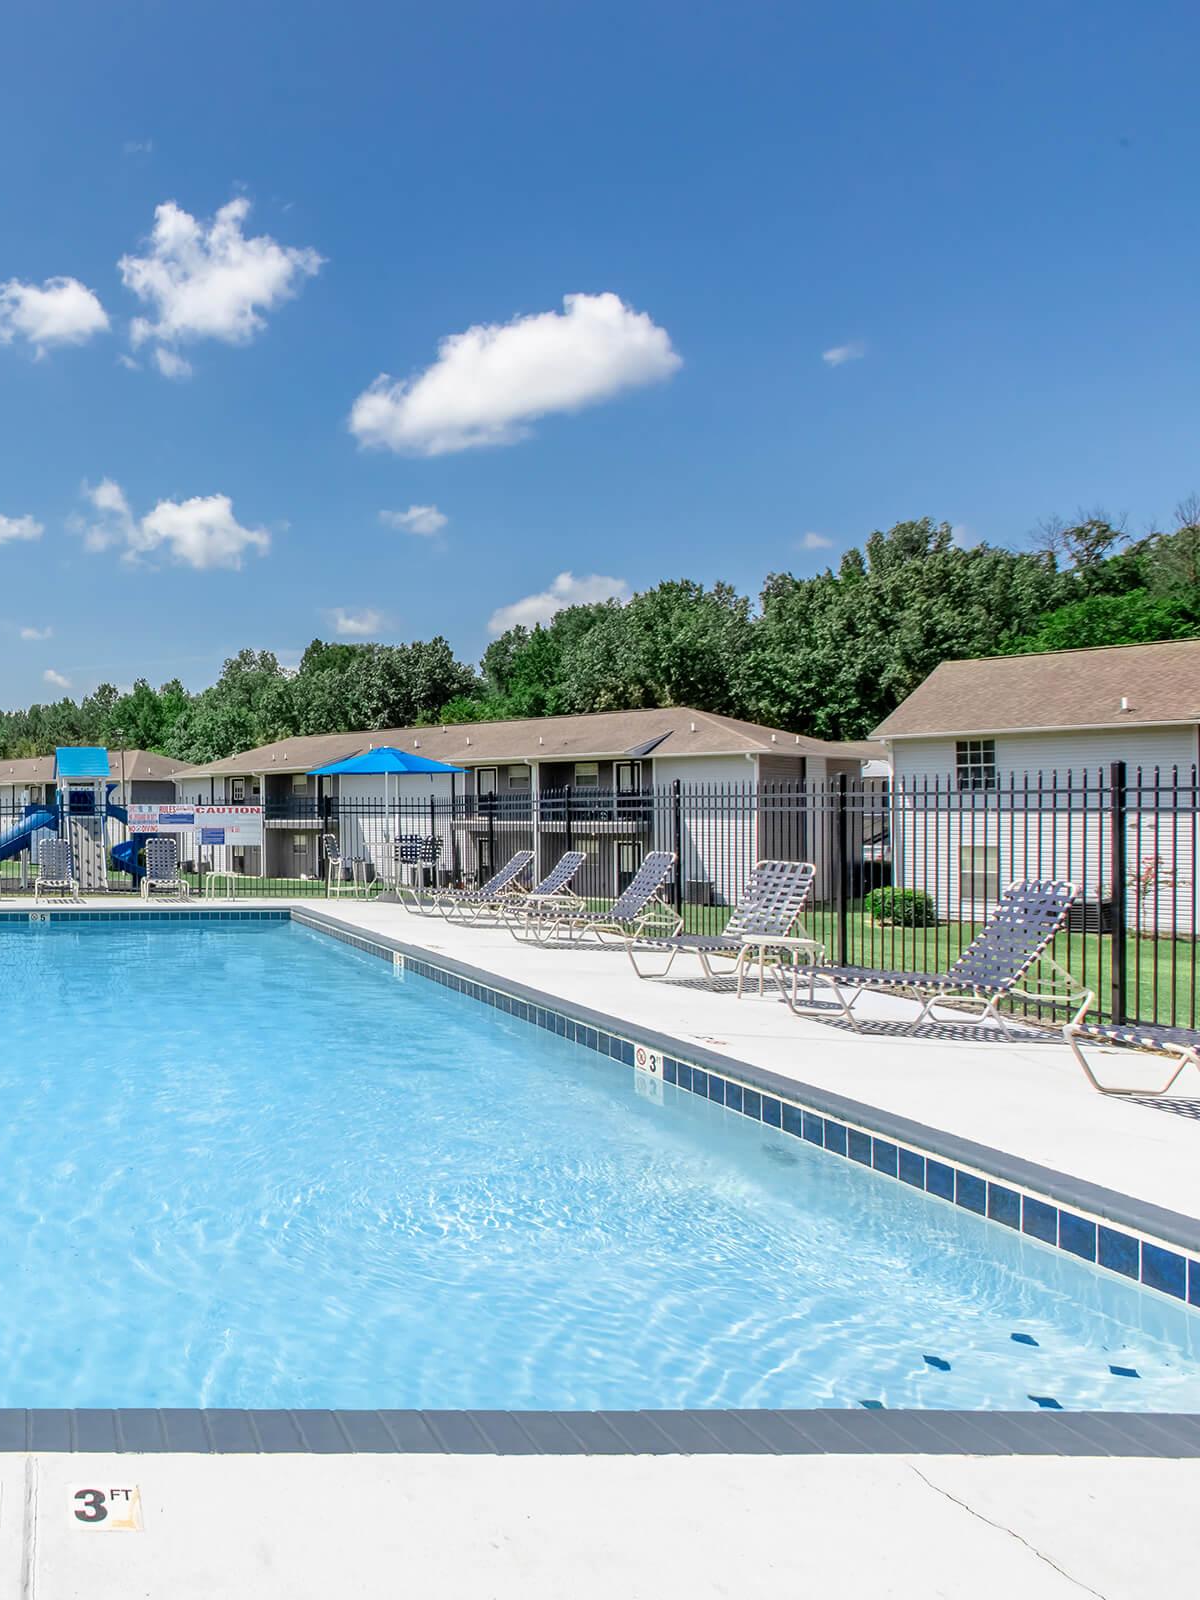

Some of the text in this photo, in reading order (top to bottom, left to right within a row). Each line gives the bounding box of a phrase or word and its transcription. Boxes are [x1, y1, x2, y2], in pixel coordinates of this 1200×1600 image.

[40, 913, 46, 922] 5
[649, 1055, 657, 1073] 3
[74, 1488, 133, 1523] 3 FT
